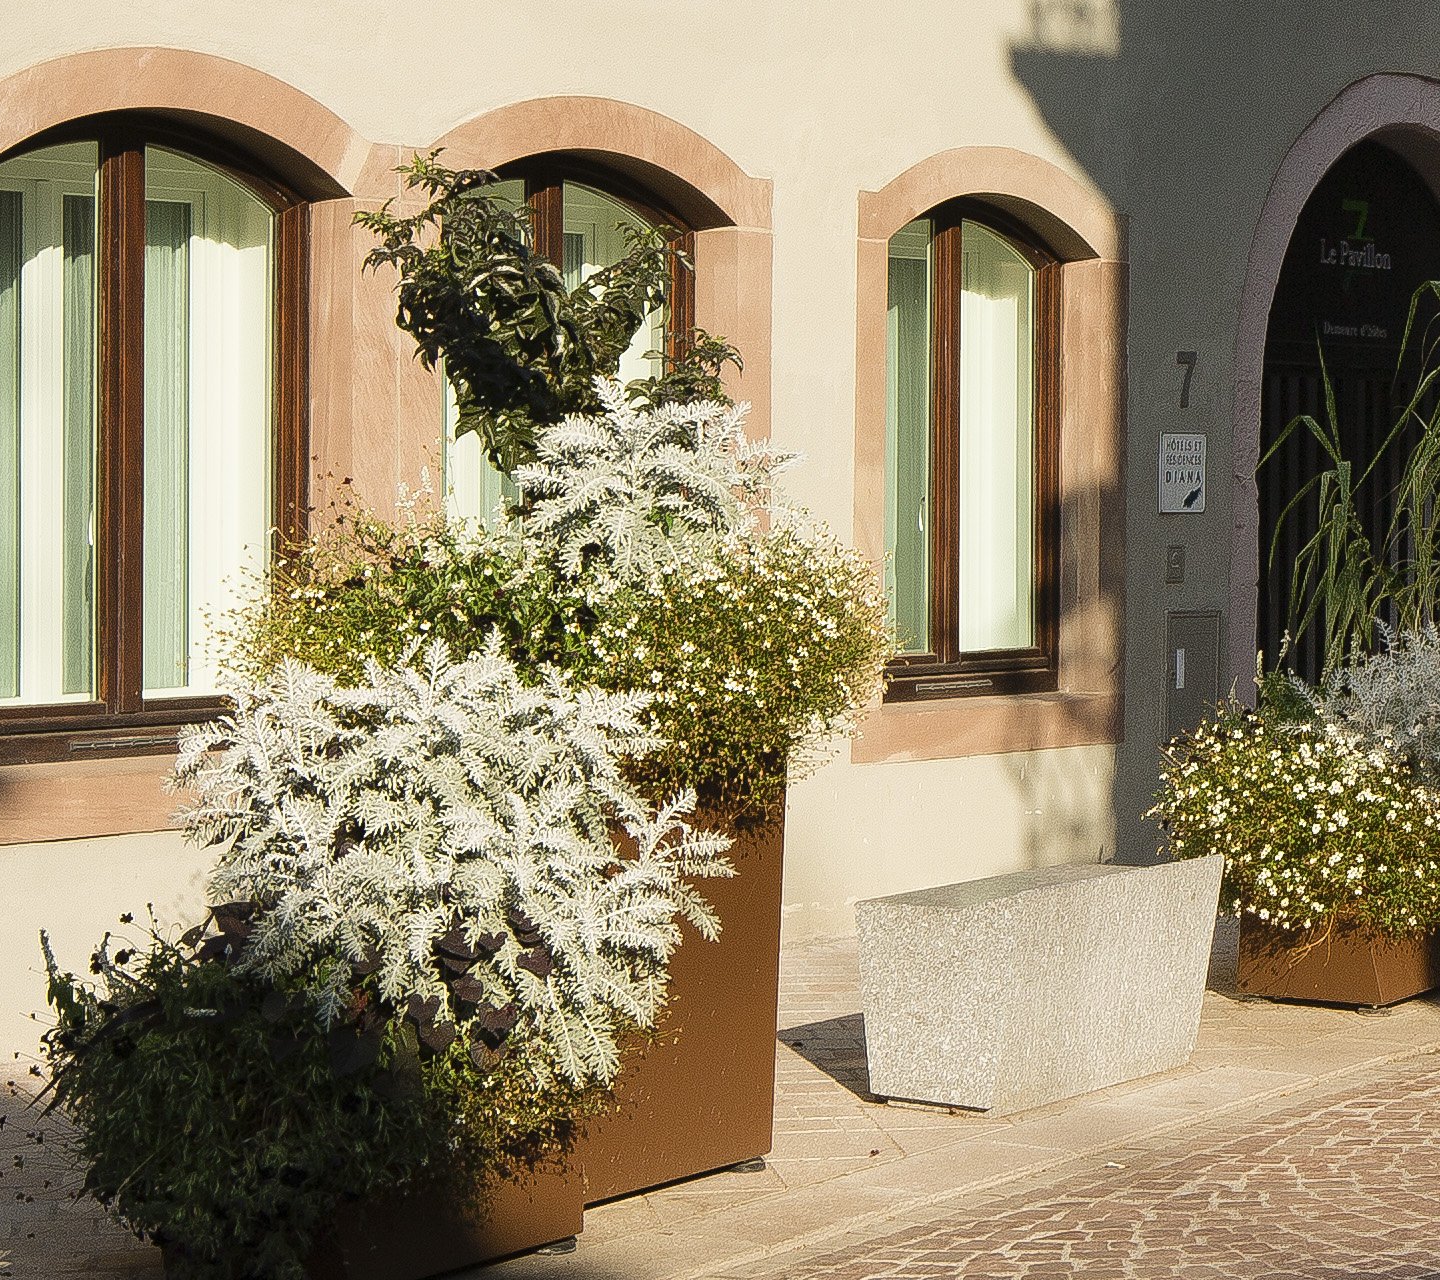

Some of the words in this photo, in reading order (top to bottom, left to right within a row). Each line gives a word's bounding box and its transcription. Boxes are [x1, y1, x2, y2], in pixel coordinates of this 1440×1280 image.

[1319, 238, 1337, 265] Le
[1339, 240, 1392, 270] Pavillon
[1177, 351, 1197, 409] 7
[1166, 437, 1192, 451] HÔTELS
[1194, 441, 1202, 451] ET
[1165, 471, 1201, 483] DIANA
